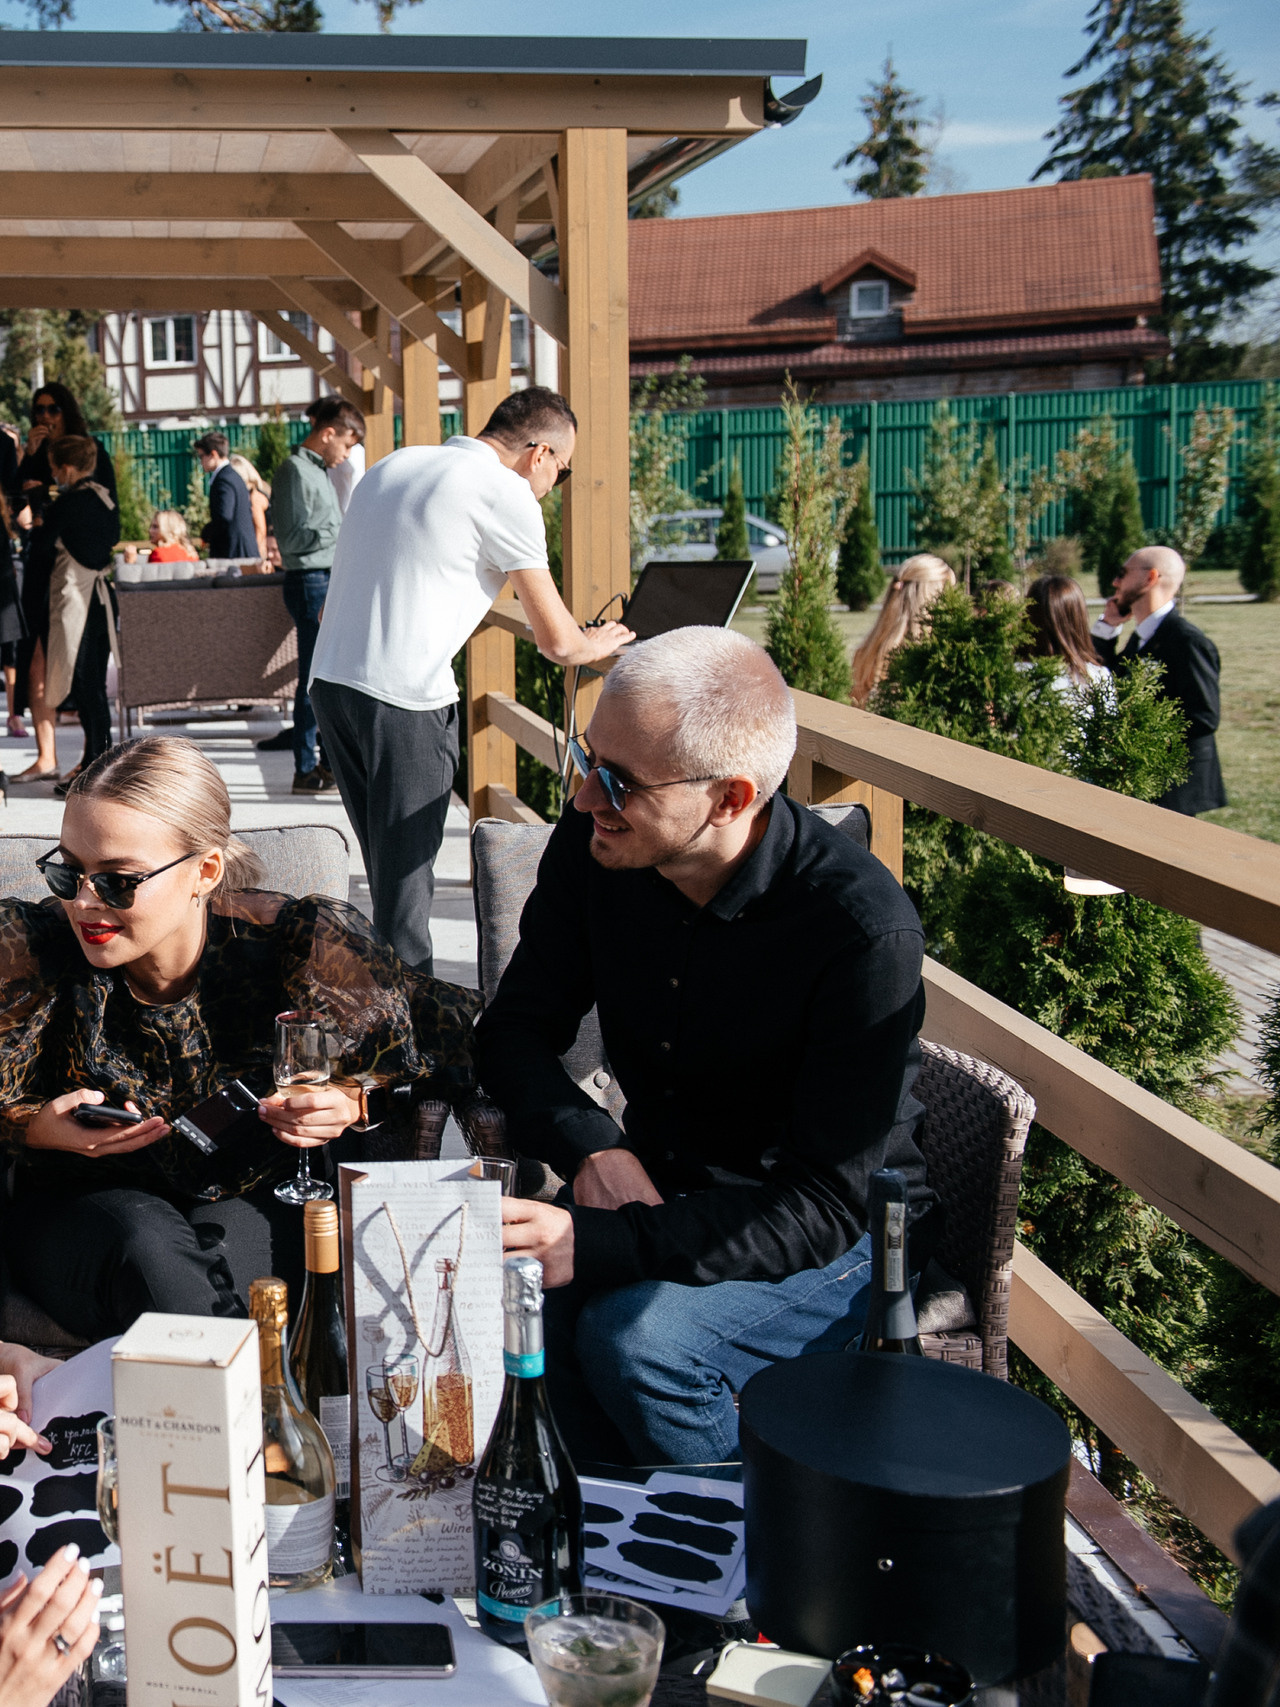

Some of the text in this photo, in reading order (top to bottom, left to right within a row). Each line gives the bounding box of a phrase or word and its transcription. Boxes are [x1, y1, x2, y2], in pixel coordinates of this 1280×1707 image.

[162, 1420, 222, 1434] CHANDON
[70, 1443, 92, 1457] KFC
[440, 1522, 473, 1535] Wine
[482, 1556, 544, 1581] ZONIN
[153, 1462, 239, 1707] OËT
[369, 1585, 386, 1595] is
[394, 1585, 446, 1595] always
